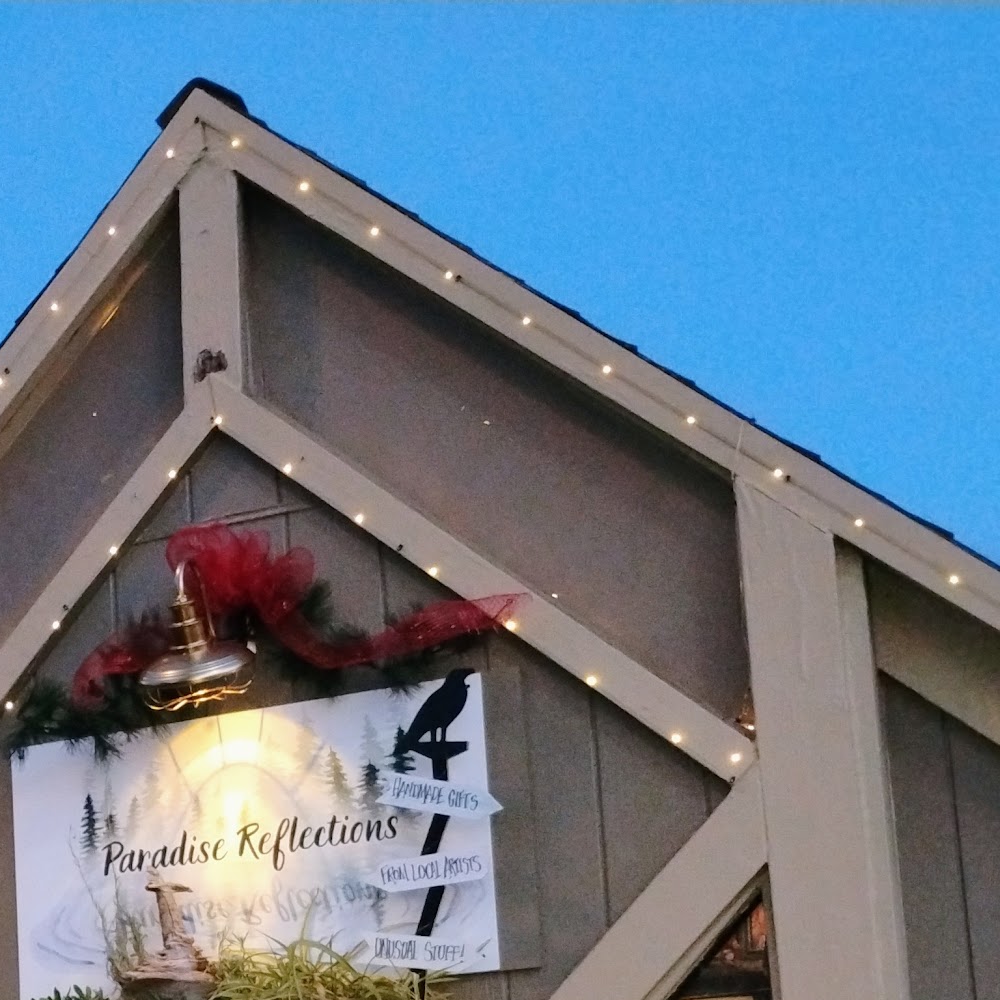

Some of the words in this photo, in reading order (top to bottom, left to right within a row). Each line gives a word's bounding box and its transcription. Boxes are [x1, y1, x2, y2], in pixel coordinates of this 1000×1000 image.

[392, 778, 445, 805] HANDMADE
[448, 788, 479, 811] GIFTS
[102, 829, 229, 876] Paradise
[236, 814, 399, 872] Reflections
[381, 863, 410, 885] FROM
[411, 860, 441, 882] LOCAL
[443, 855, 482, 879] ARTISTS
